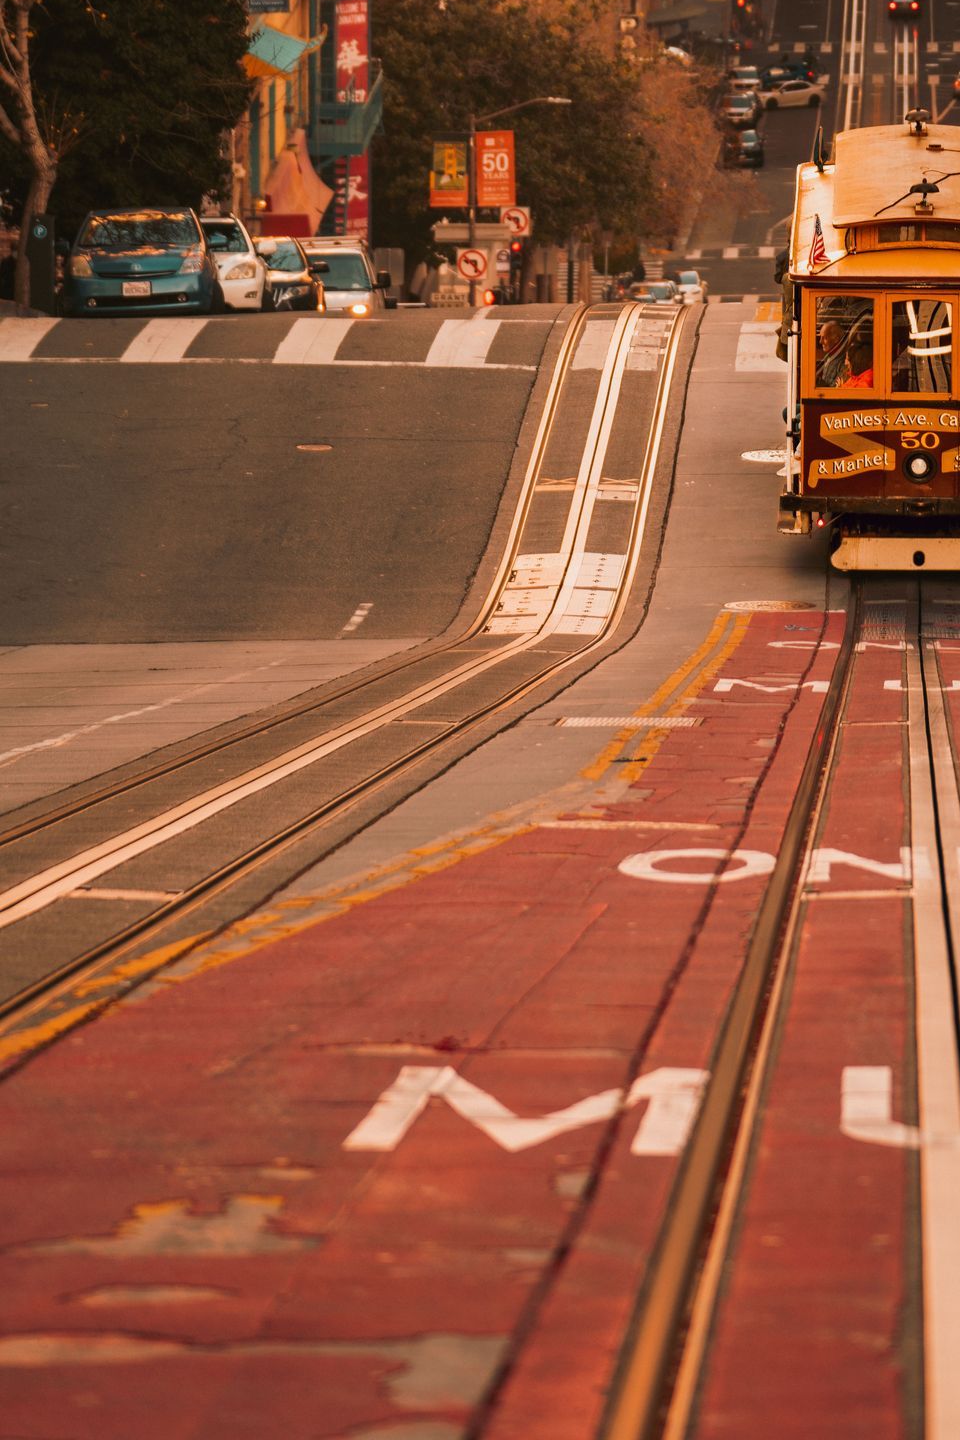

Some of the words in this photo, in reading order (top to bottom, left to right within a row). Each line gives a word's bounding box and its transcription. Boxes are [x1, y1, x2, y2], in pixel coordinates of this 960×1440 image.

[482, 153, 509, 172] 50
[824, 415, 851, 430] Van
[853, 412, 890, 427] Ness
[900, 431, 940, 449] 50
[817, 461, 828, 475] &
[832, 452, 889, 474] Market
